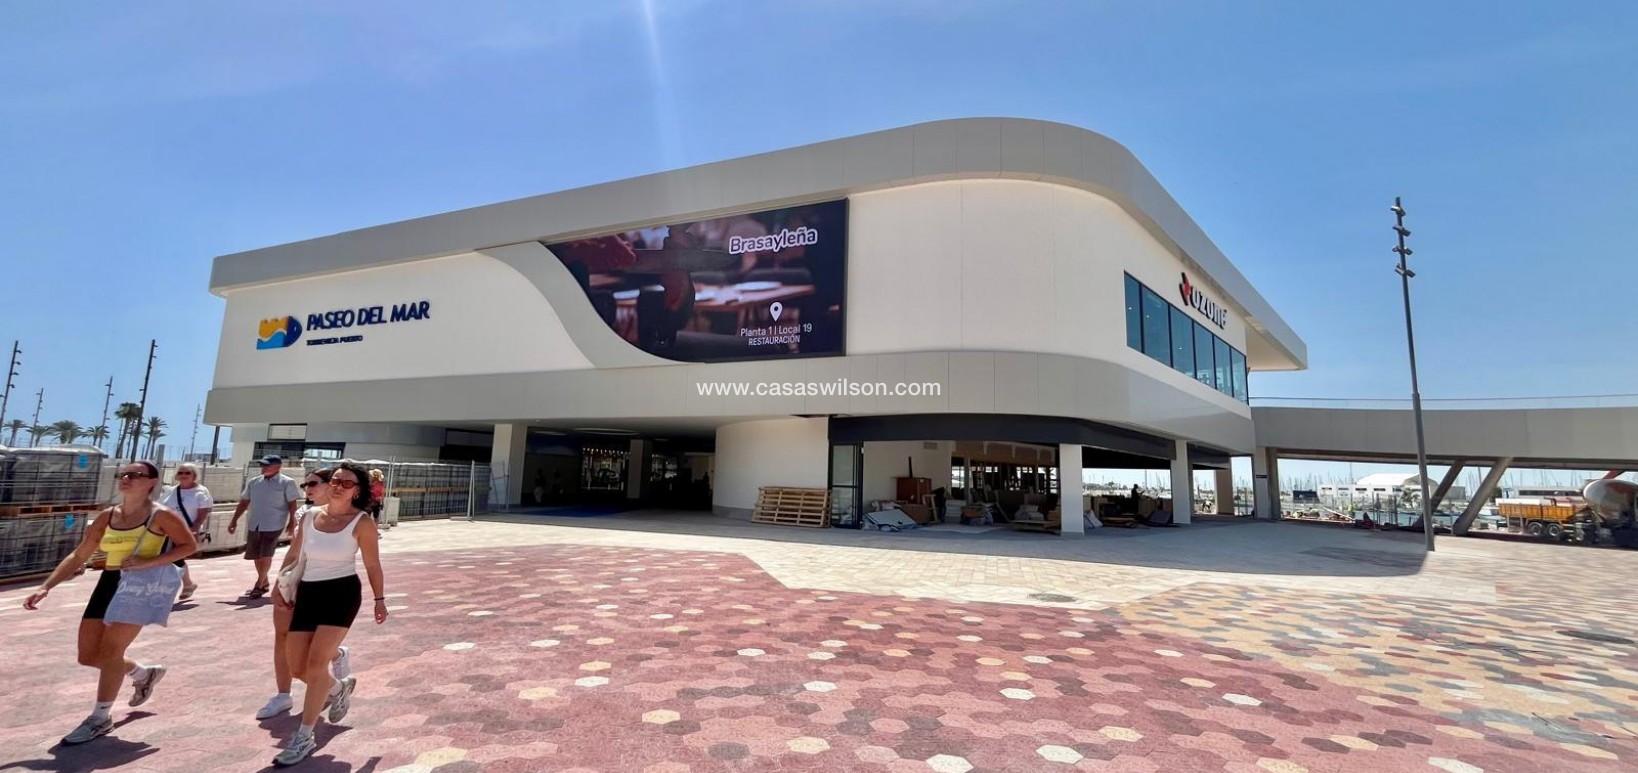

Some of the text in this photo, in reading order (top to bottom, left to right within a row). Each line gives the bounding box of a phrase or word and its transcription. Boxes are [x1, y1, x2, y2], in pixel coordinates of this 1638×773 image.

[729, 227, 818, 254] Brasayleña
[306, 301, 430, 331] PASEO DEL MAR
[740, 327, 767, 337] Planta
[778, 323, 801, 335] Local
[802, 322, 813, 333] 19
[748, 334, 801, 346] RESTAURACIÓN
